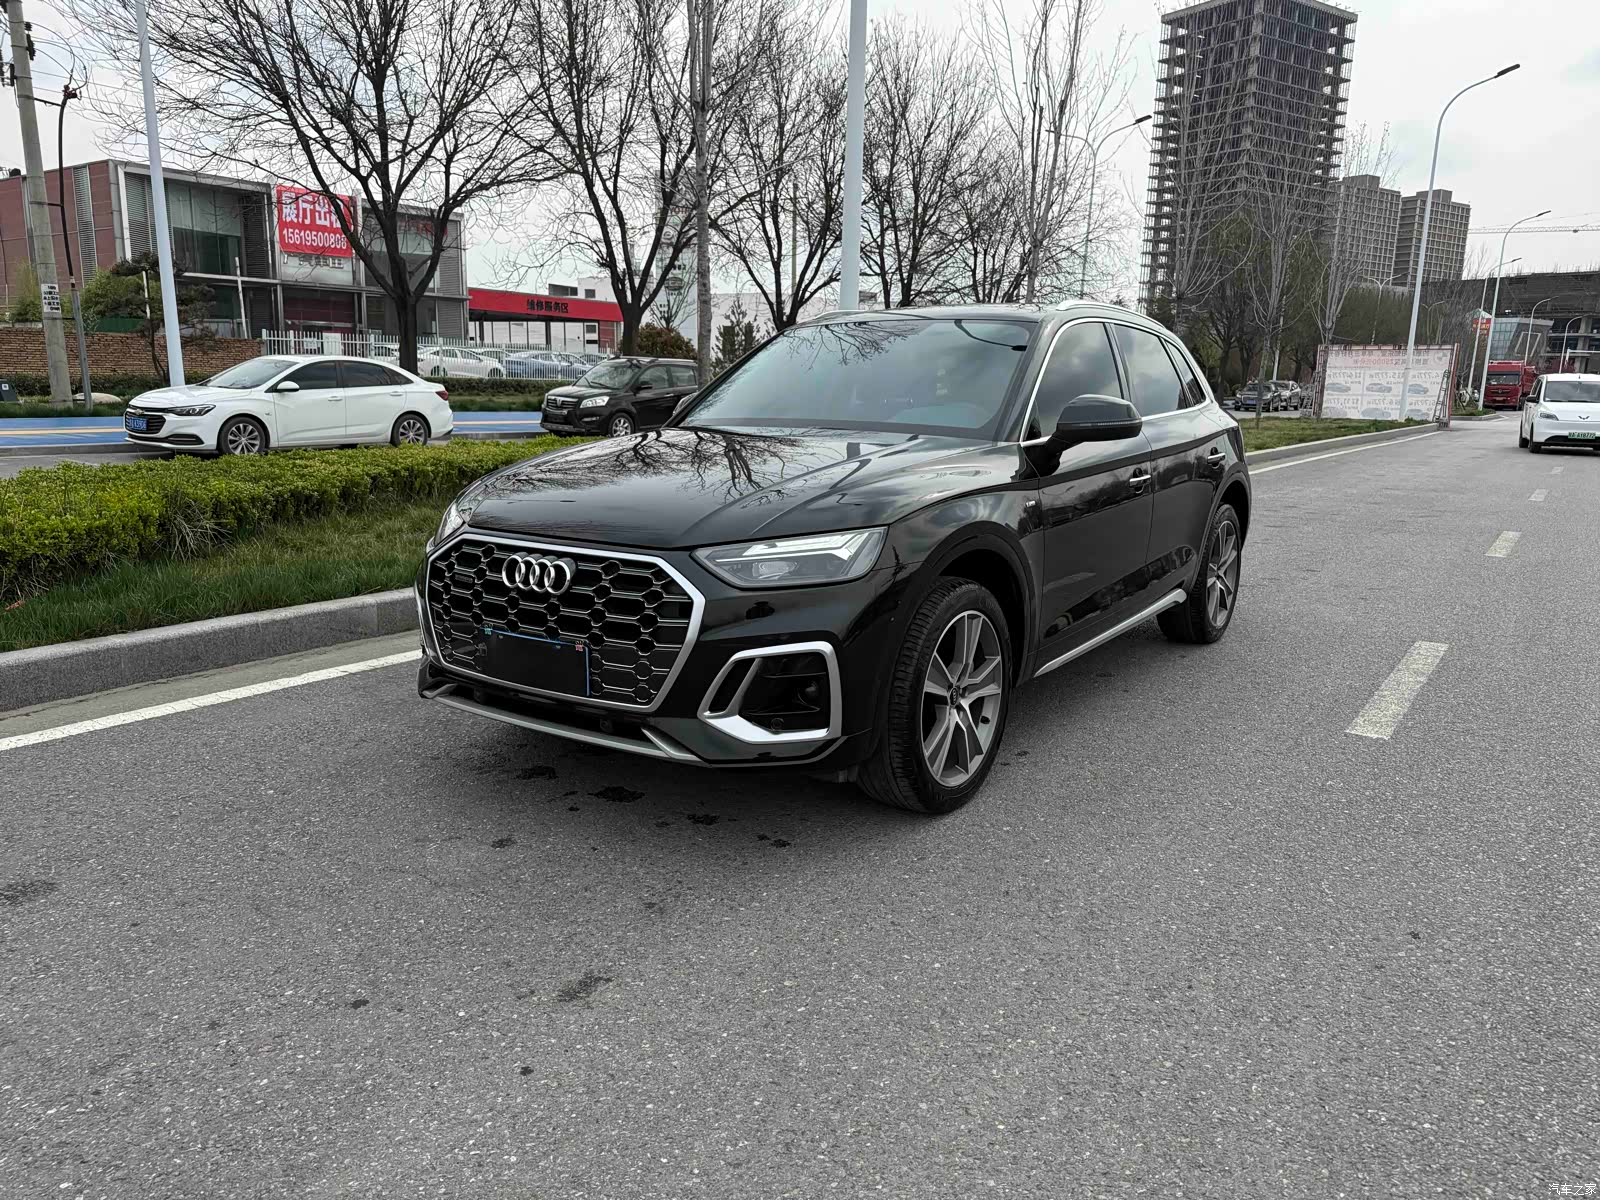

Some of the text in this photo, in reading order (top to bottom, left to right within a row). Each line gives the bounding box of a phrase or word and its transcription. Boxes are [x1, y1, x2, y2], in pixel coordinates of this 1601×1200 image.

[282, 228, 347, 249] 15619500808
[527, 299, 568, 313] 维修服务区
